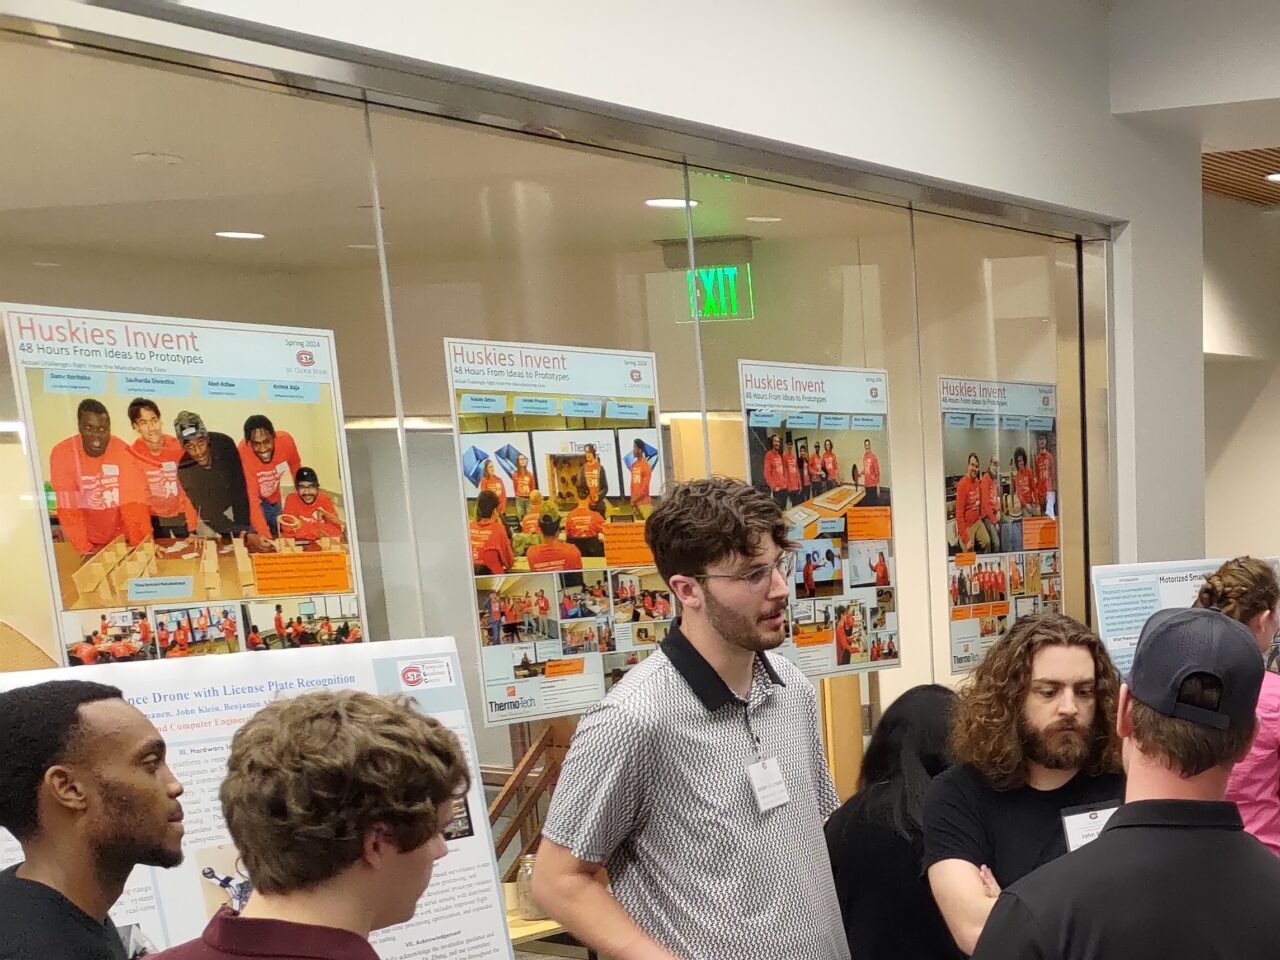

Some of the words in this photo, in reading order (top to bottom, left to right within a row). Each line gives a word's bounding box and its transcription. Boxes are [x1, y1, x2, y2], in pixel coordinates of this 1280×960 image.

[687, 264, 738, 317] EXIT
[17, 316, 117, 346] Huskies
[124, 324, 200, 352] Invent
[285, 339, 305, 349] Spring
[306, 340, 321, 348] 2024
[19, 342, 33, 353] 48
[37, 344, 71, 356] Hours
[73, 346, 101, 358] From
[105, 348, 132, 361] Ideas
[135, 351, 146, 361] to
[149, 351, 204, 365] Prototypes
[453, 345, 515, 367] Huskies
[519, 350, 568, 370] Invent
[453, 366, 463, 375] 48
[464, 367, 486, 376] Hours
[486, 368, 505, 378] From
[506, 369, 524, 379] Ideas
[525, 371, 534, 379] to
[534, 371, 570, 382] Prototypes
[744, 373, 789, 391] Huskies
[791, 377, 826, 393] Invent
[942, 381, 977, 398] Huskies
[979, 384, 1007, 399] Invent
[753, 392, 768, 400] Hours
[768, 393, 782, 401] From
[782, 394, 796, 402] Ideas
[802, 395, 828, 405] Prototypes
[1159, 574, 1189, 584] Motorized
[152, 689, 190, 705] Drone
[193, 686, 220, 698] with
[223, 681, 265, 696] License
[267, 680, 295, 692] Plate
[296, 673, 356, 689] Recognition
[176, 707, 197, 717] John
[224, 702, 261, 712] Benjamin
[170, 721, 212, 732] Computer
[190, 745, 225, 755] Hardware
[125, 904, 157, 915] real-time
[416, 929, 462, 946] Acknowledgement
